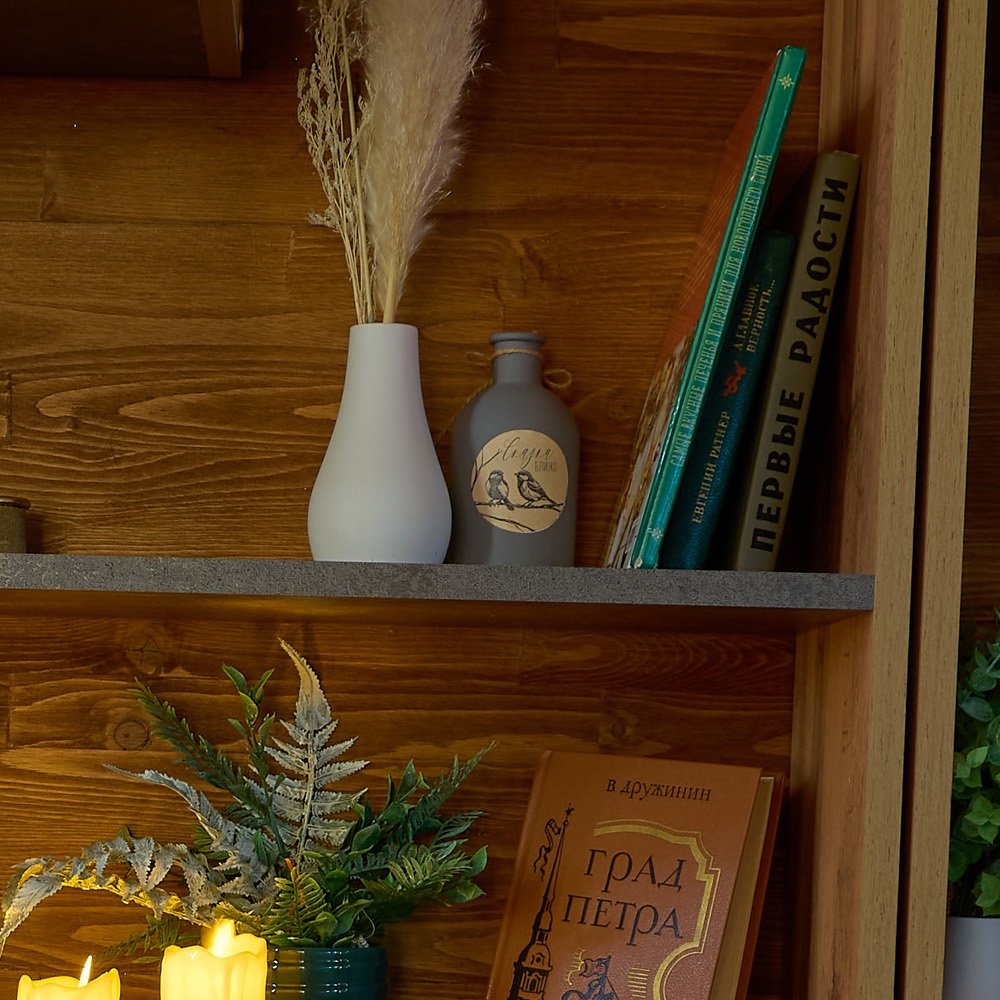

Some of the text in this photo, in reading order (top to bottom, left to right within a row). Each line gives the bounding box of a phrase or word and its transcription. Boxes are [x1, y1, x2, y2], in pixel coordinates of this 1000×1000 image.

[670, 154, 773, 467] САМЫЕ ВКУСНЫЕ ПЕЧЕНЬЯ И ПРЯНИКИ ДЛЯ НОВОГОДНЕГО СТОЛА
[746, 280, 775, 353] ВЕРНОСТЬ...
[733, 343, 743, 351] А
[750, 178, 849, 552] ПЕРВЫЕ РАДОСТИ
[691, 410, 730, 524] ЕВГЕНИЙ РАТНЕР
[620, 779, 712, 801] ДРУЖИНИН
[584, 849, 687, 893] ГРАД
[562, 894, 683, 946] ПЕТРА
